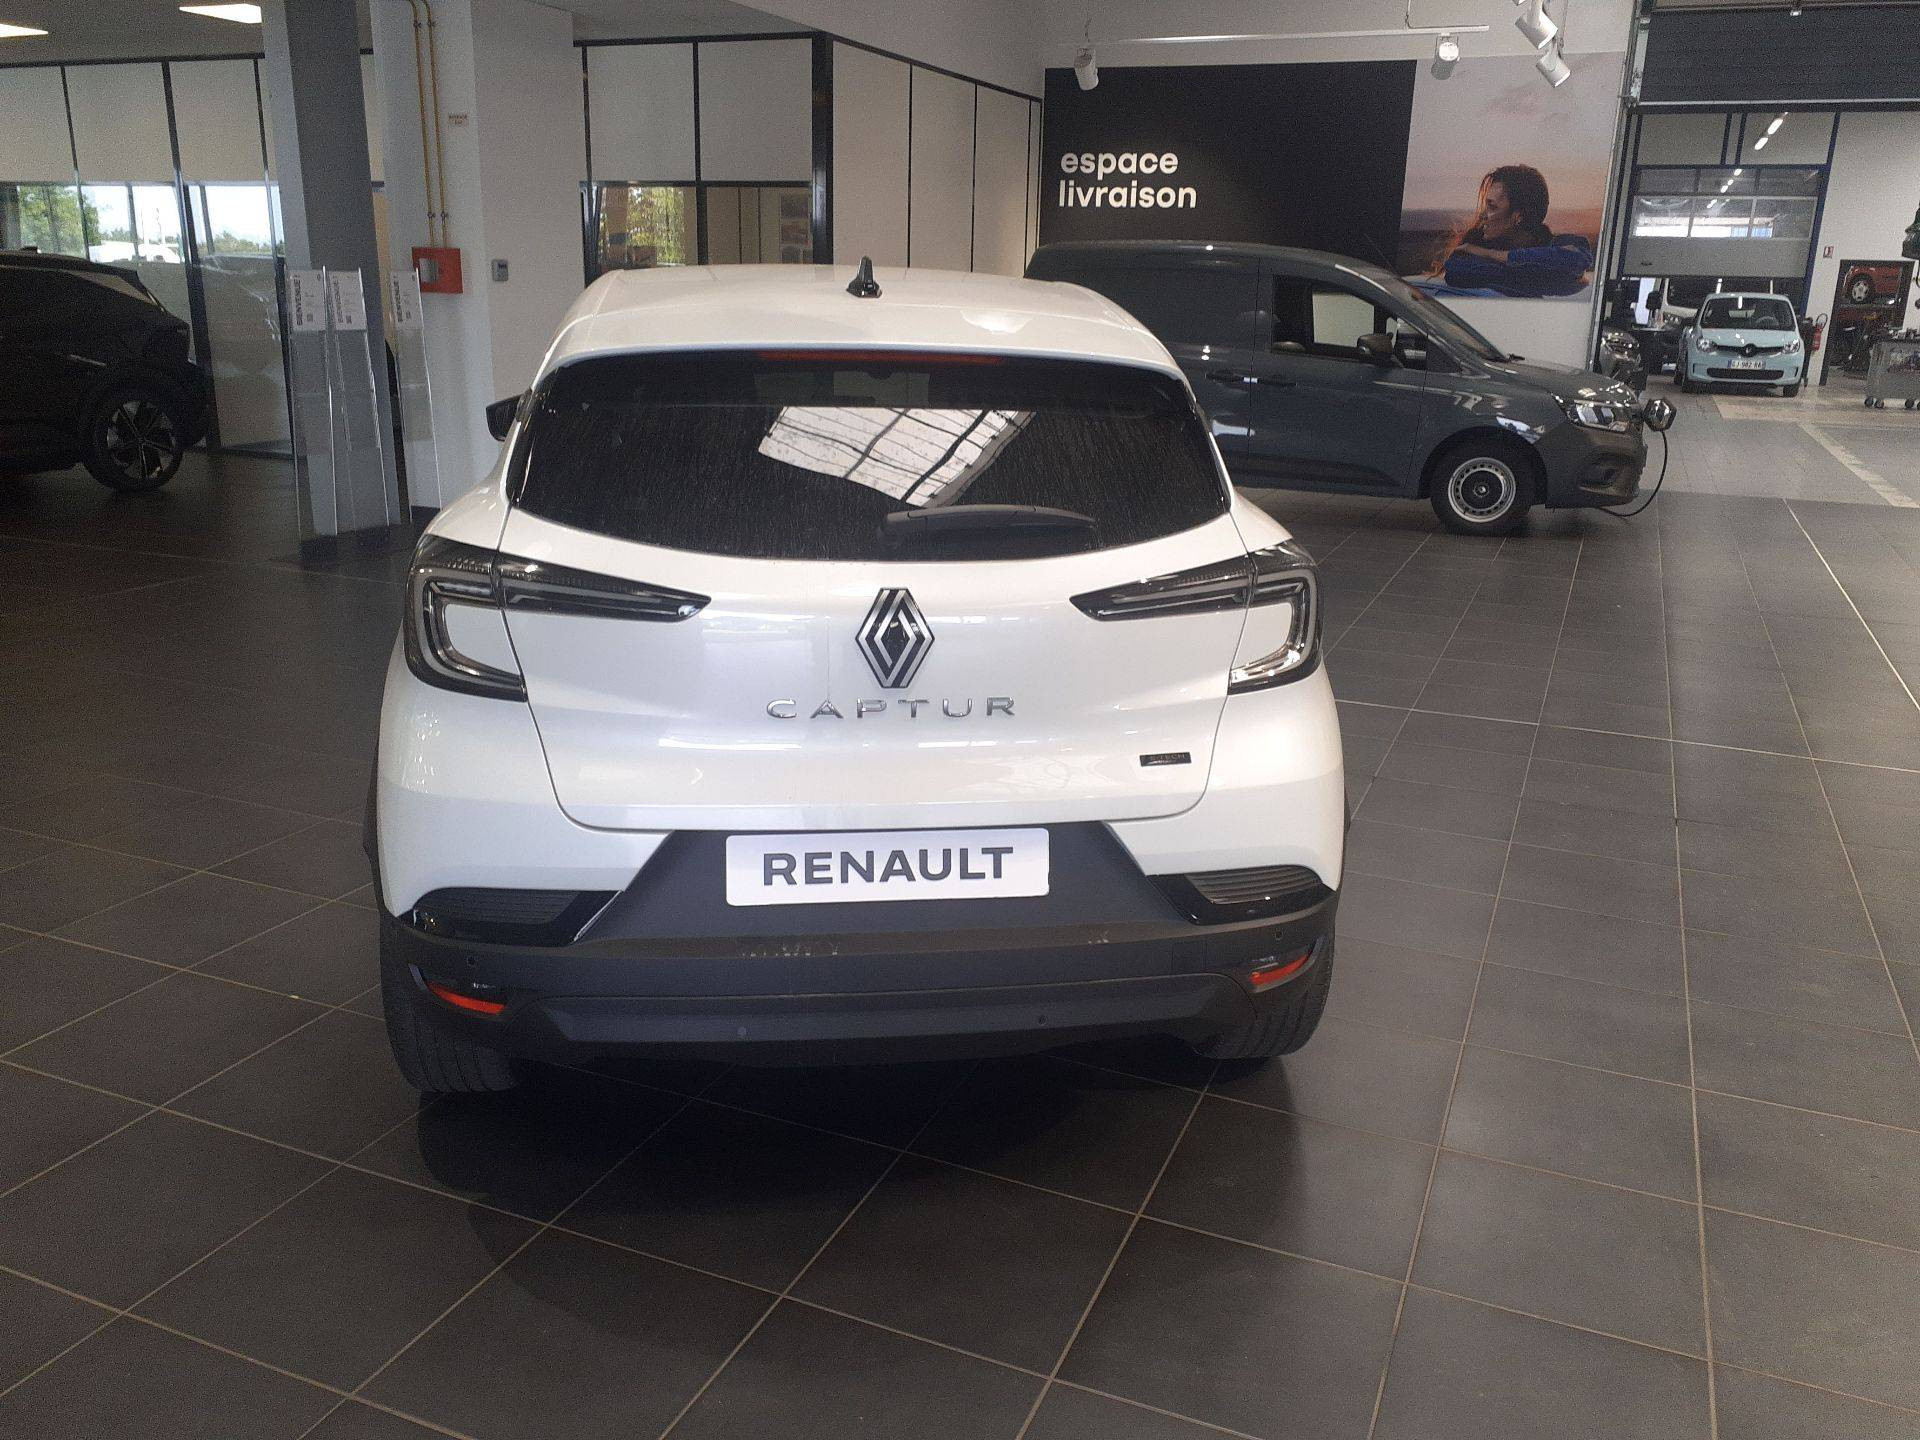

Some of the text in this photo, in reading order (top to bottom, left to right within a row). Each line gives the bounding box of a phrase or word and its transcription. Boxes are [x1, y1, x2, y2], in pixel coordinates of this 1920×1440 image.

[1061, 152, 1179, 180] espace
[1059, 180, 1198, 208] livraison
[766, 697, 1015, 719] CAPTUR
[763, 846, 1014, 886] RENAULT
